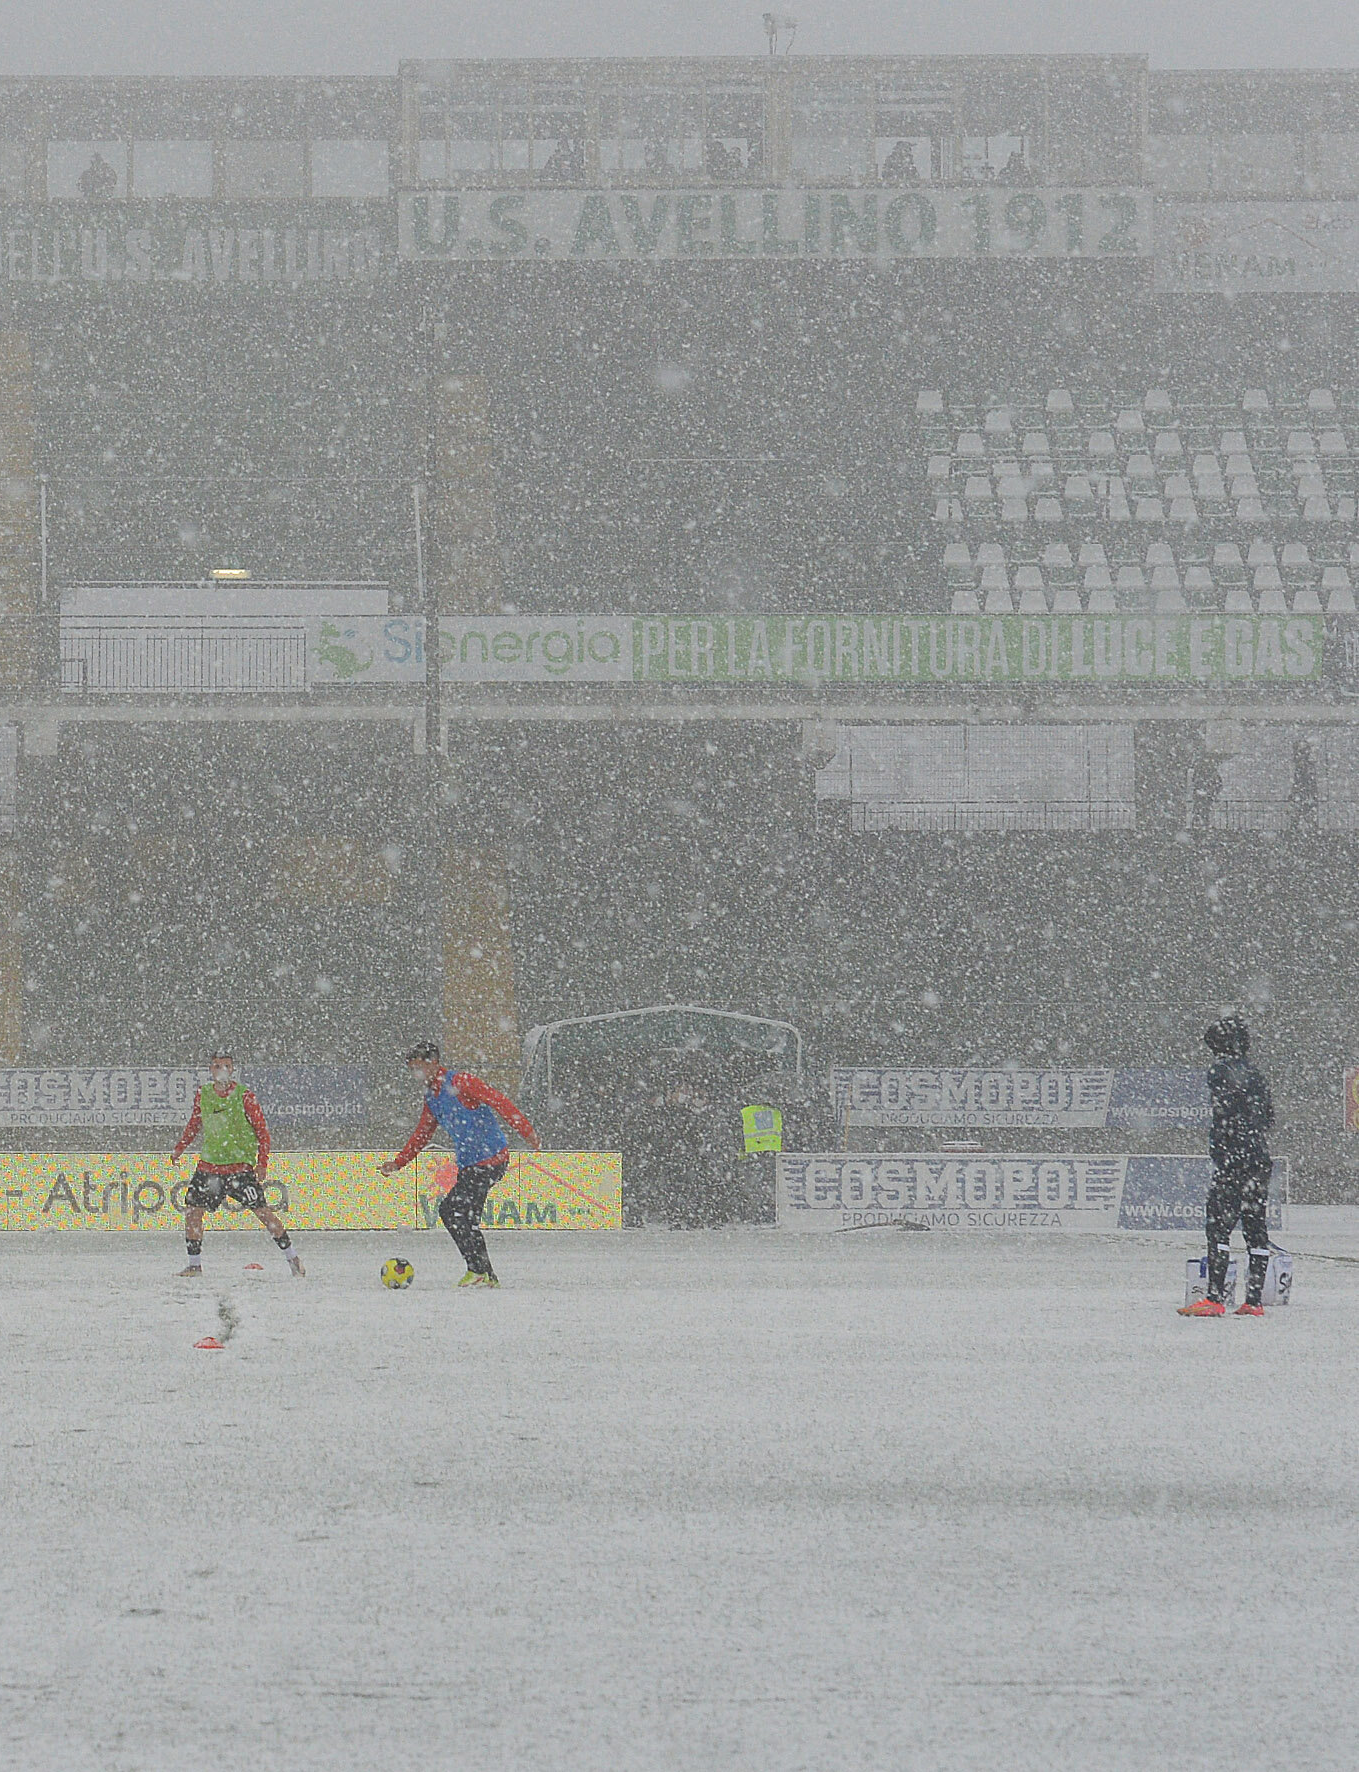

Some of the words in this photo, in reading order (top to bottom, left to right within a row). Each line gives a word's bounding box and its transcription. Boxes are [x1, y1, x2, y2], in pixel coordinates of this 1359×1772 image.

[412, 195, 550, 255] U.S.
[570, 194, 936, 256] AVELLINO
[962, 193, 1138, 254] 1912
[182, 228, 382, 283] AVELLINO
[643, 619, 714, 676] PER
[727, 619, 771, 676] LA
[784, 618, 1010, 677] FORNITURA
[1022, 619, 1058, 677] DI
[1070, 619, 1178, 677] LUCE
[1190, 619, 1214, 677] E
[1225, 619, 1315, 676] GAS
[851, 1071, 1097, 1111] COSMOPOL
[10, 1112, 106, 1125] PRODUCIAMO
[881, 1112, 977, 1125] PRODUCIAMO
[983, 1113, 1060, 1124] SICUREZZA
[804, 1161, 1105, 1210] COSMOPOL
[969, 1212, 1062, 1226] SICUREZZA
